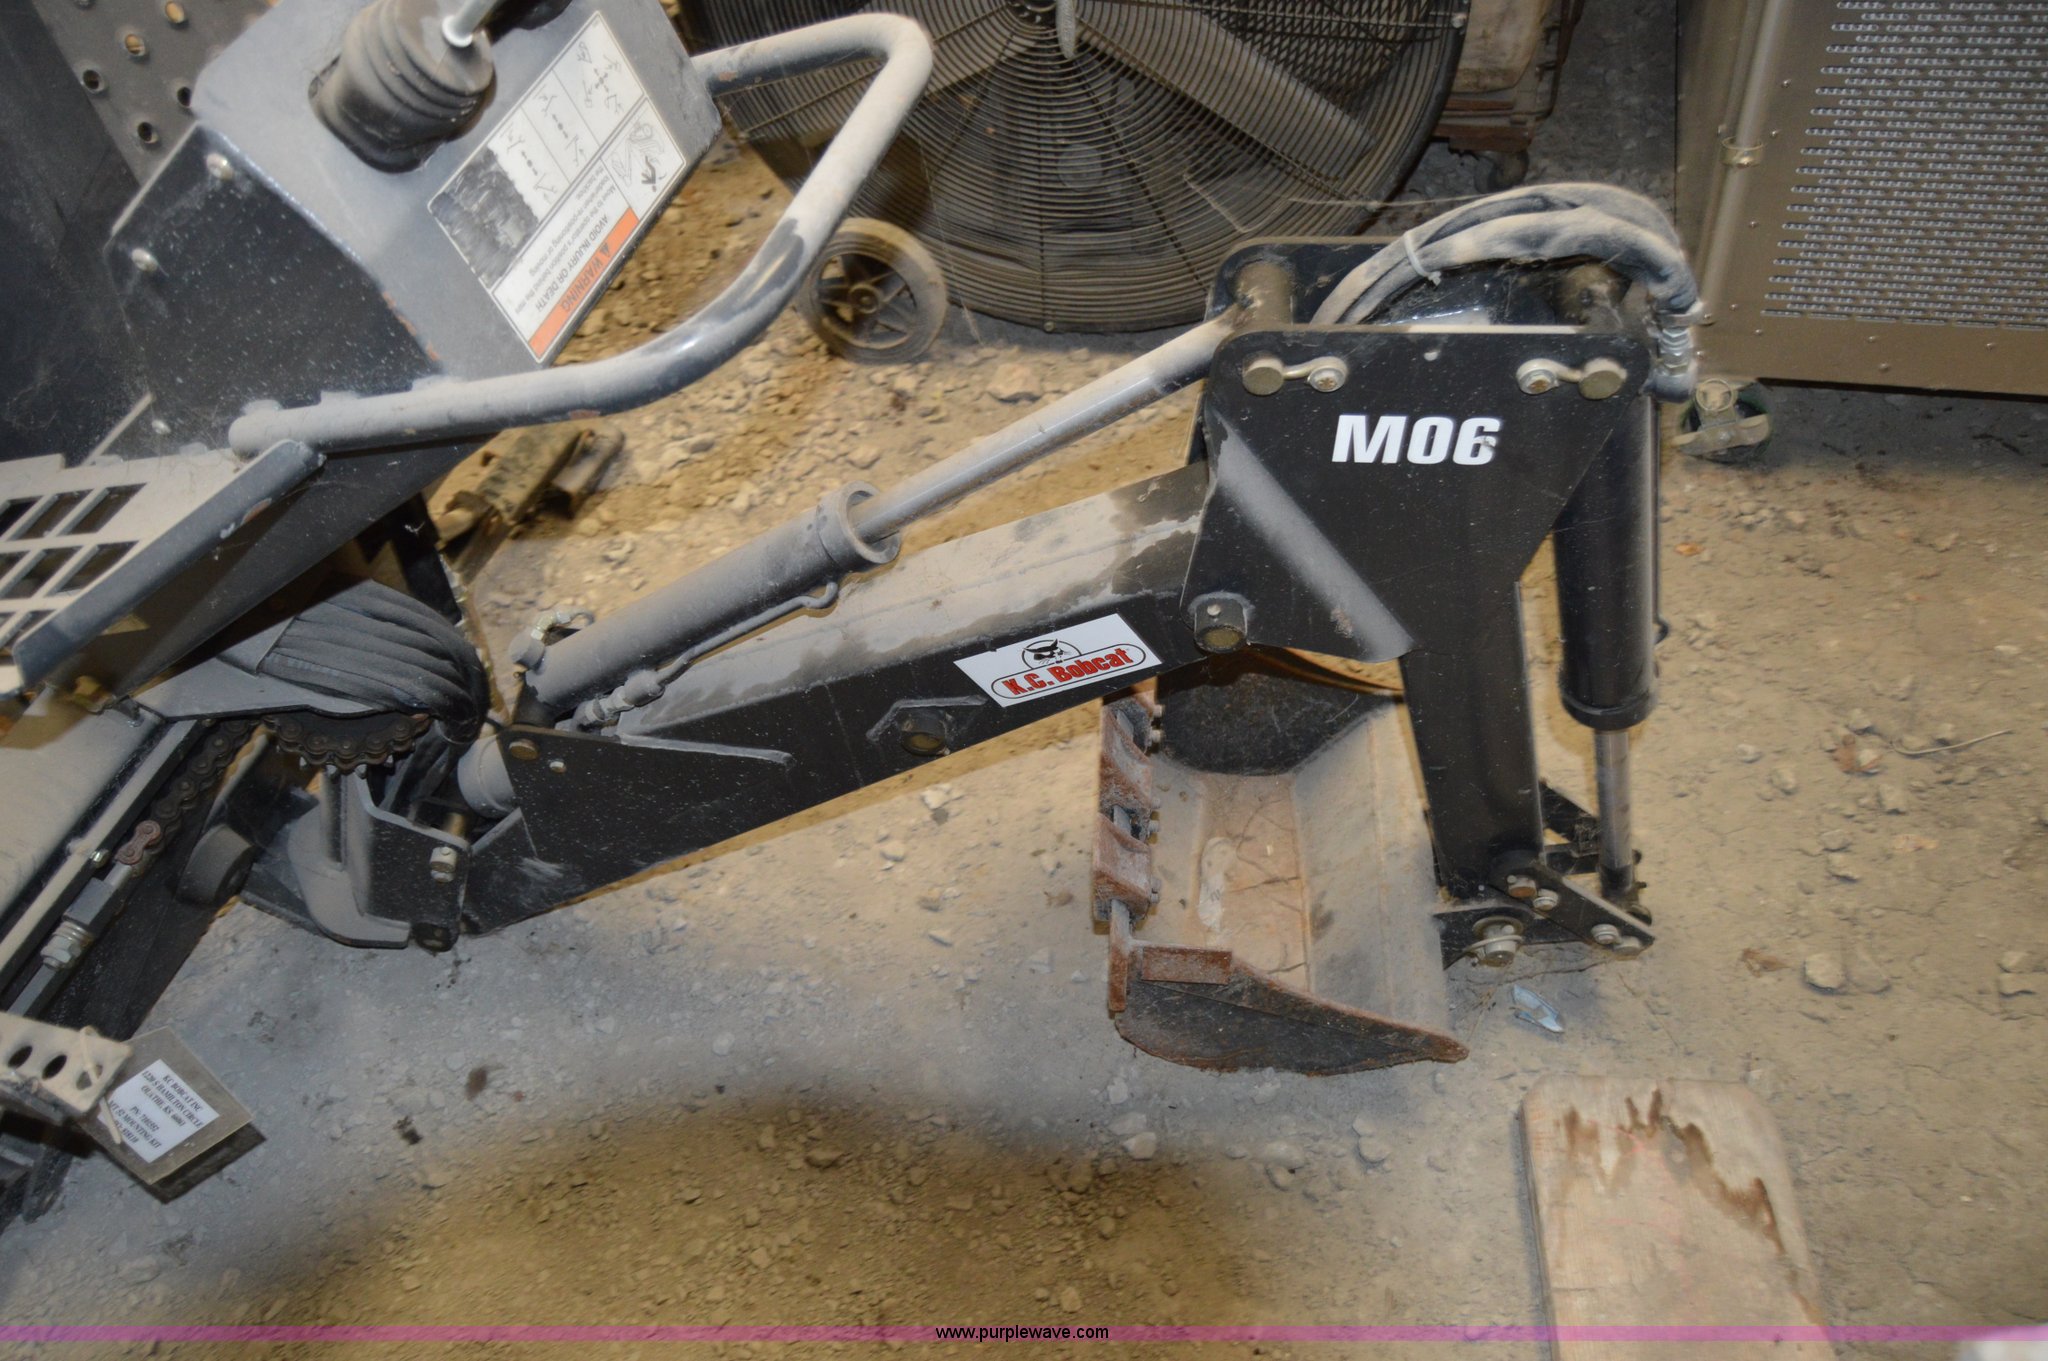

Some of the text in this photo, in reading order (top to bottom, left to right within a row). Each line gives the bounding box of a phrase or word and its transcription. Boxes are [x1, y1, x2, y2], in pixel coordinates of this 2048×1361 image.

[534, 213, 609, 312] AVOID INJURY OR DEATH
[559, 254, 603, 313] WARNING
[1331, 414, 1502, 466] M06
[1001, 647, 1134, 695] K.C. Bobcat
[154, 1083, 186, 1112] HAMILTON
[180, 1108, 204, 1128] CIRCLE
[161, 1074, 203, 1112] KC BOBCAT INC
[121, 1113, 153, 1141] MOUNTING
[148, 1137, 162, 1149] KIT
